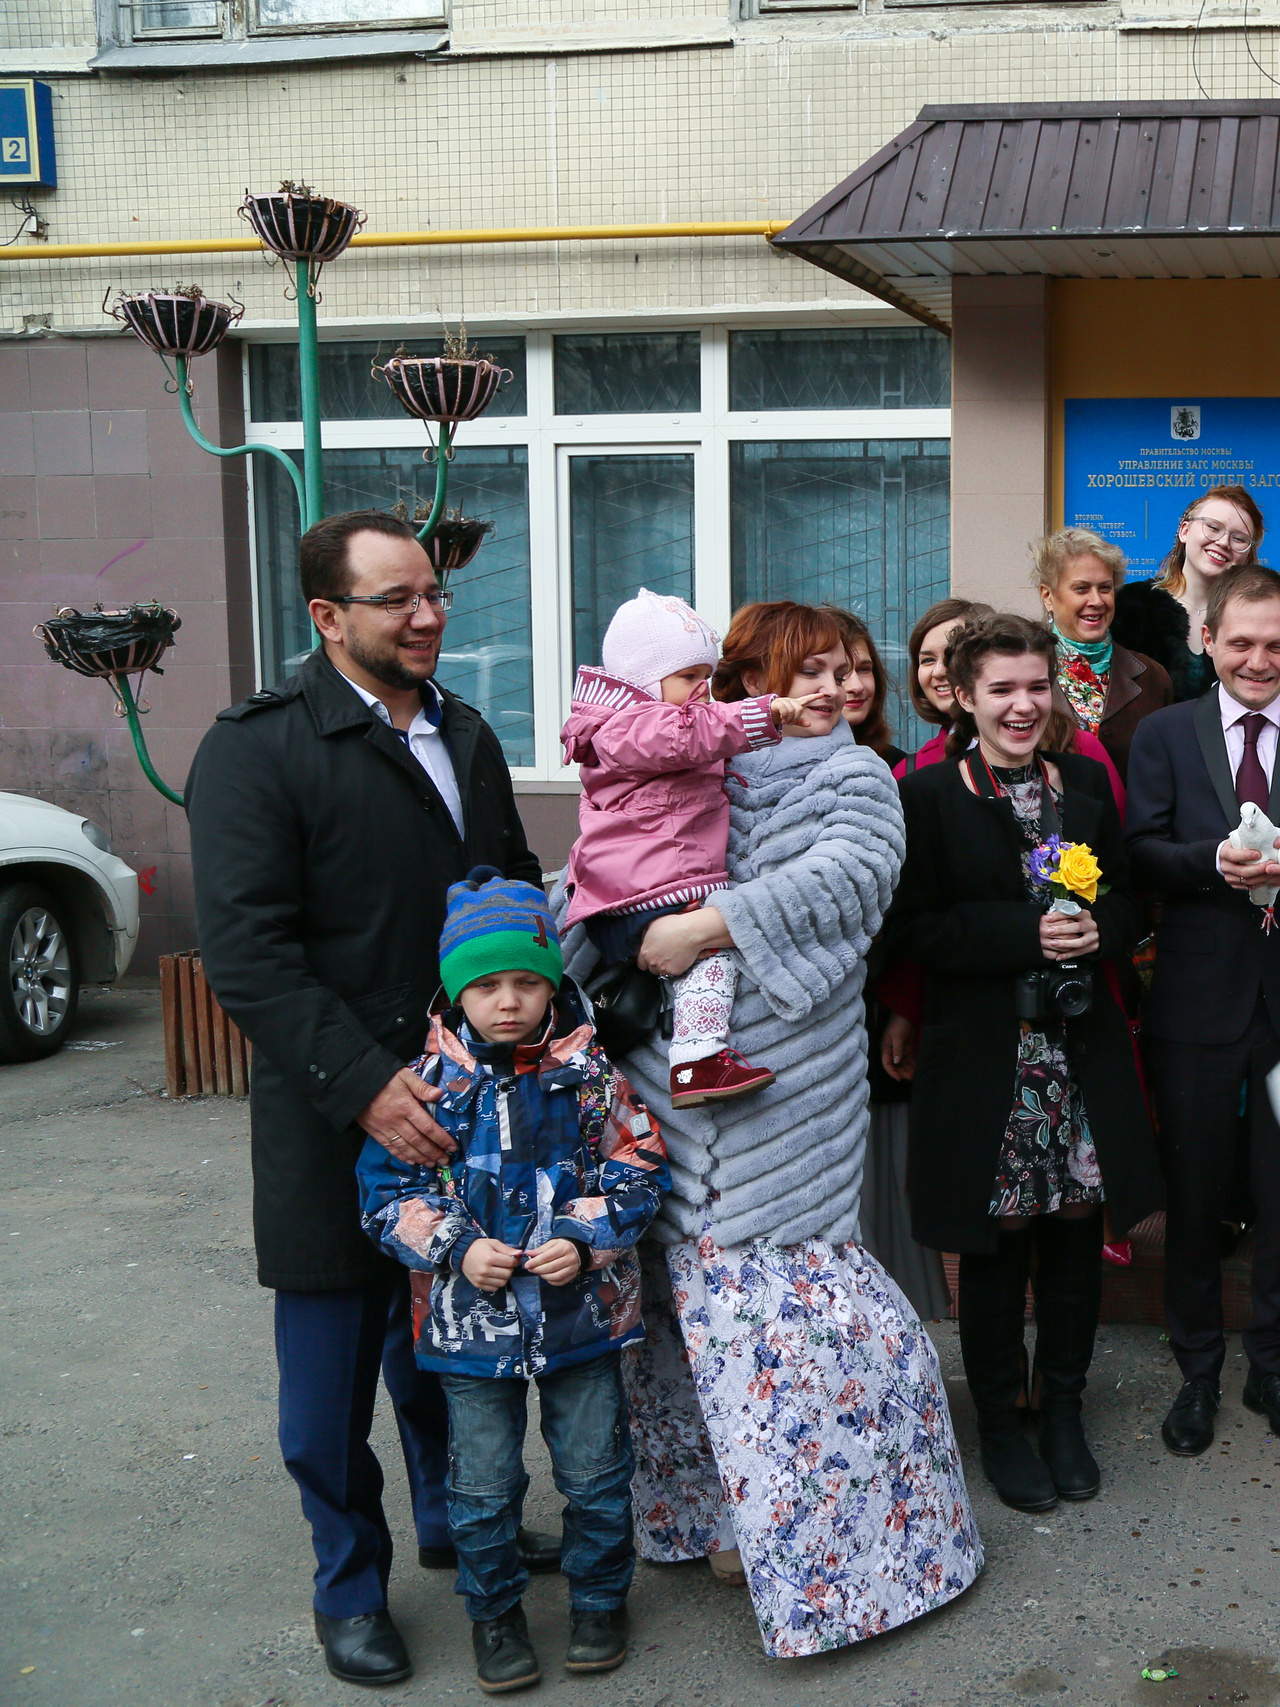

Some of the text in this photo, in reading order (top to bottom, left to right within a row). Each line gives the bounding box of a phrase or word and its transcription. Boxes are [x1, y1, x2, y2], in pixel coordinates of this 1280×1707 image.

[8, 140, 21, 159] 2
[1140, 448, 1232, 456] ПРАВИТЕЛЬСТВО МОСКВЫ
[1118, 460, 1254, 470] УПРАВЛЕНИЕ ЗАГС МОСКВЫ
[1087, 472, 1195, 487] ХОРОШЕВСКИЙ
[1200, 474, 1245, 487] ОТДЕЛ
